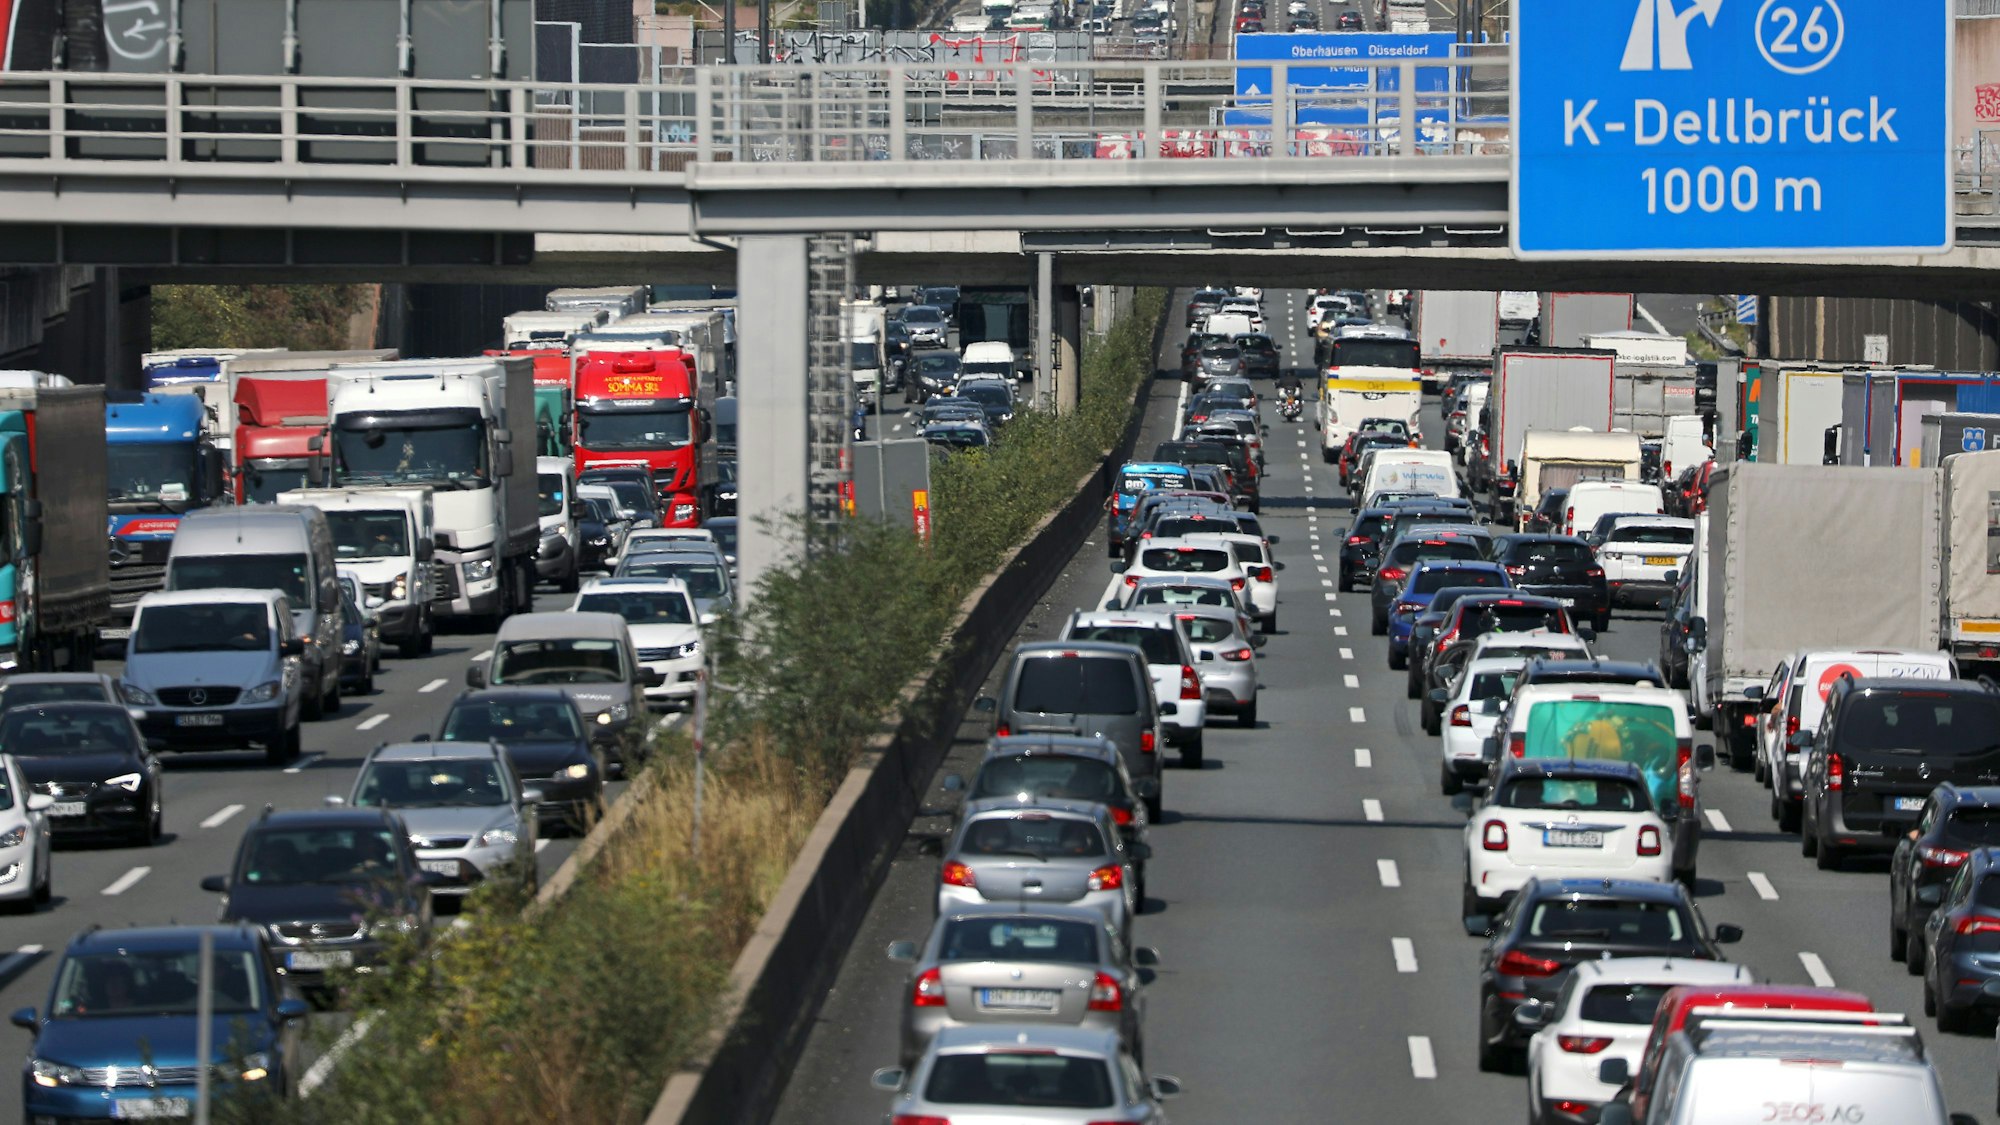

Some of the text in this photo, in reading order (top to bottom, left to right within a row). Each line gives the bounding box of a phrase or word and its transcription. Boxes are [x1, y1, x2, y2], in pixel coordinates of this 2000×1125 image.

[1291, 44, 1429, 57] Oberhausen Düsseldorf
[1770, 6, 1828, 53] 26
[1564, 95, 1899, 146] K-Dellbrück
[1641, 165, 1822, 215] 1000 m
